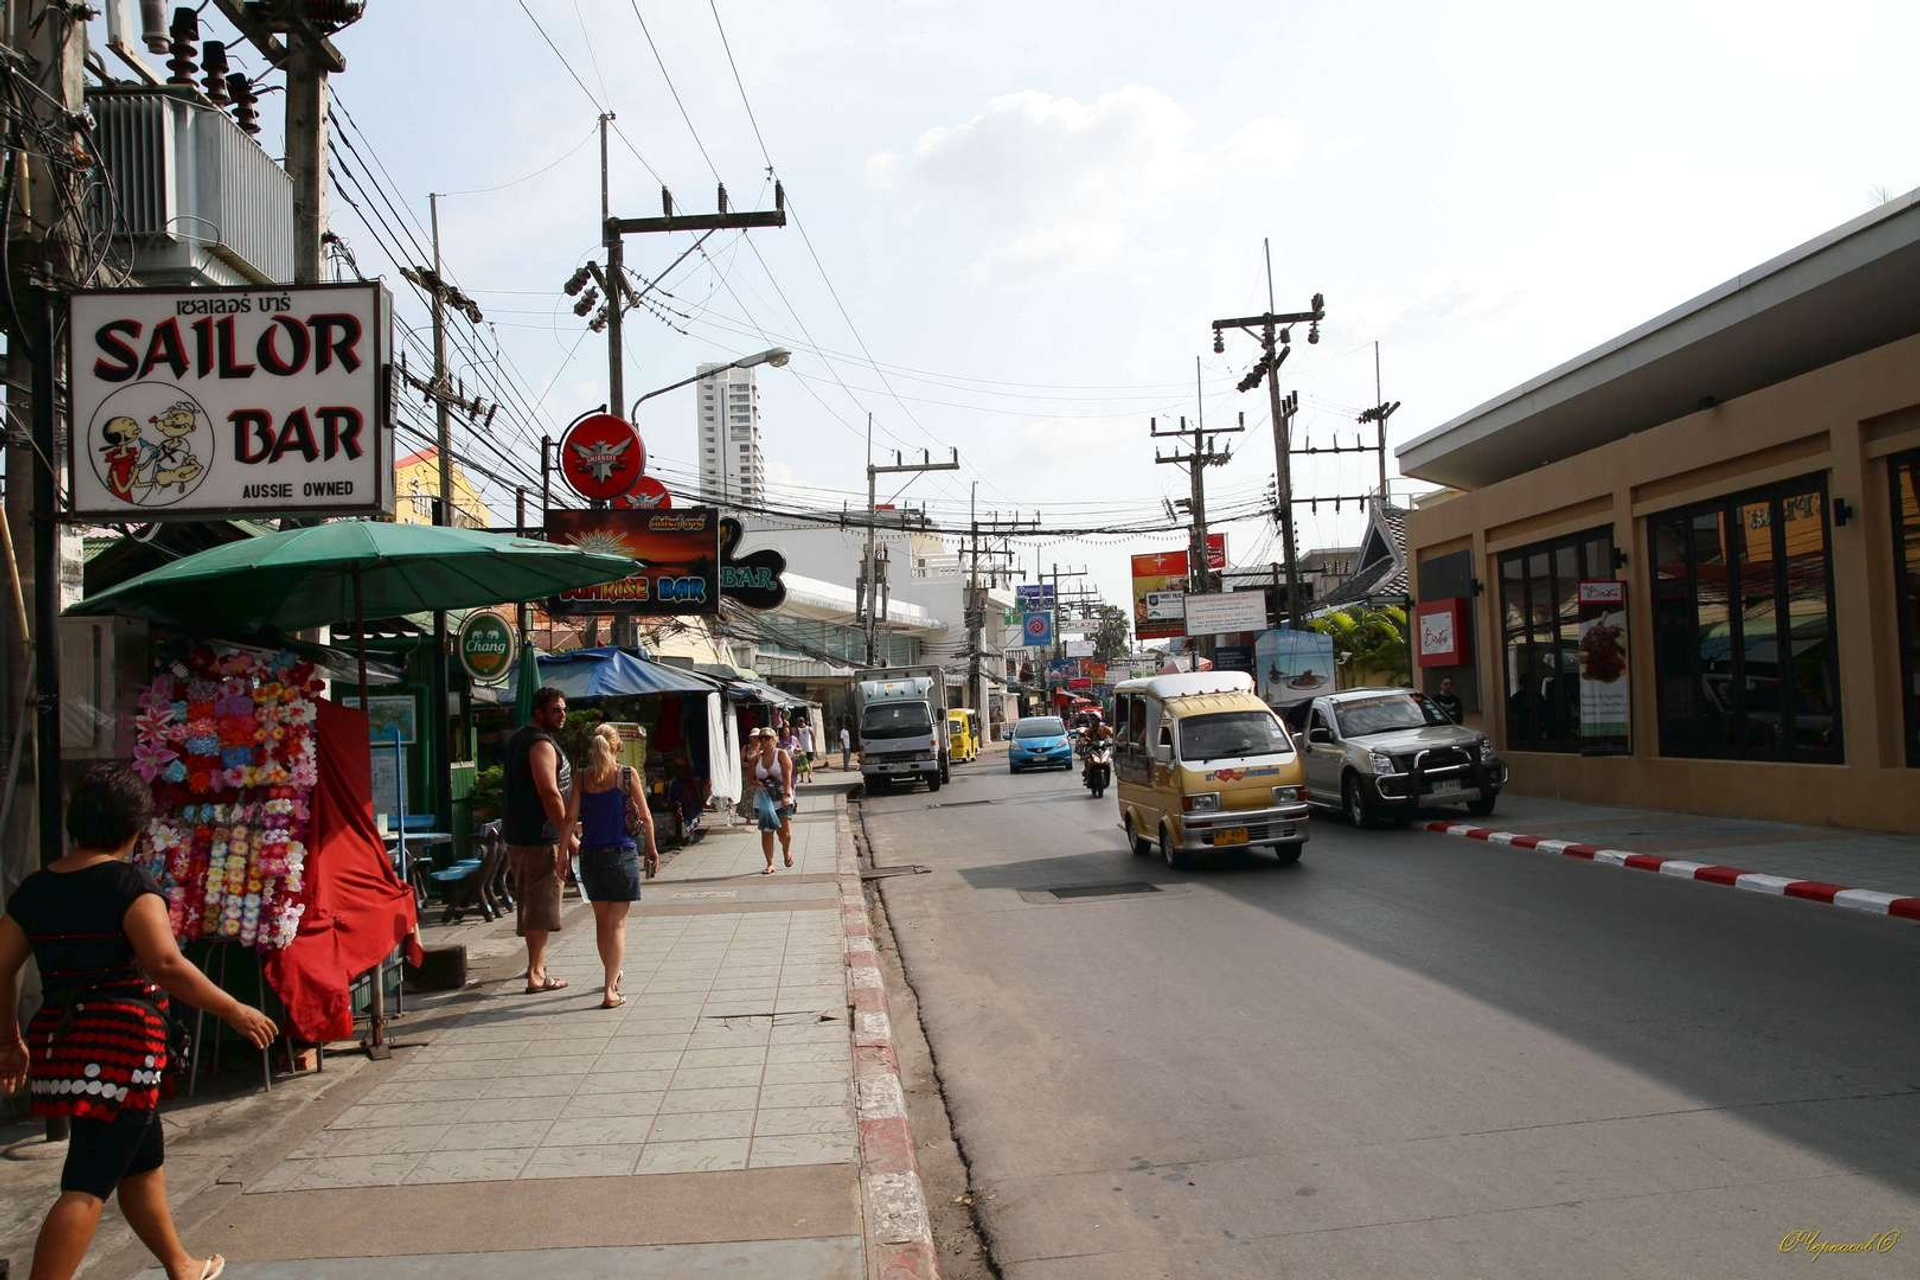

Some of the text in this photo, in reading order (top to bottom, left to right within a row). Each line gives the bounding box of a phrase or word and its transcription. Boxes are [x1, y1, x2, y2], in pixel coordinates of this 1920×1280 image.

[259, 292, 291, 312] บาร์
[94, 313, 363, 382] SAILOR
[227, 406, 364, 465] BAR
[242, 481, 354, 499] AUSSIE OWNED
[721, 567, 777, 589] BAR
[659, 577, 706, 602] BAR
[466, 640, 506, 654] Chang
